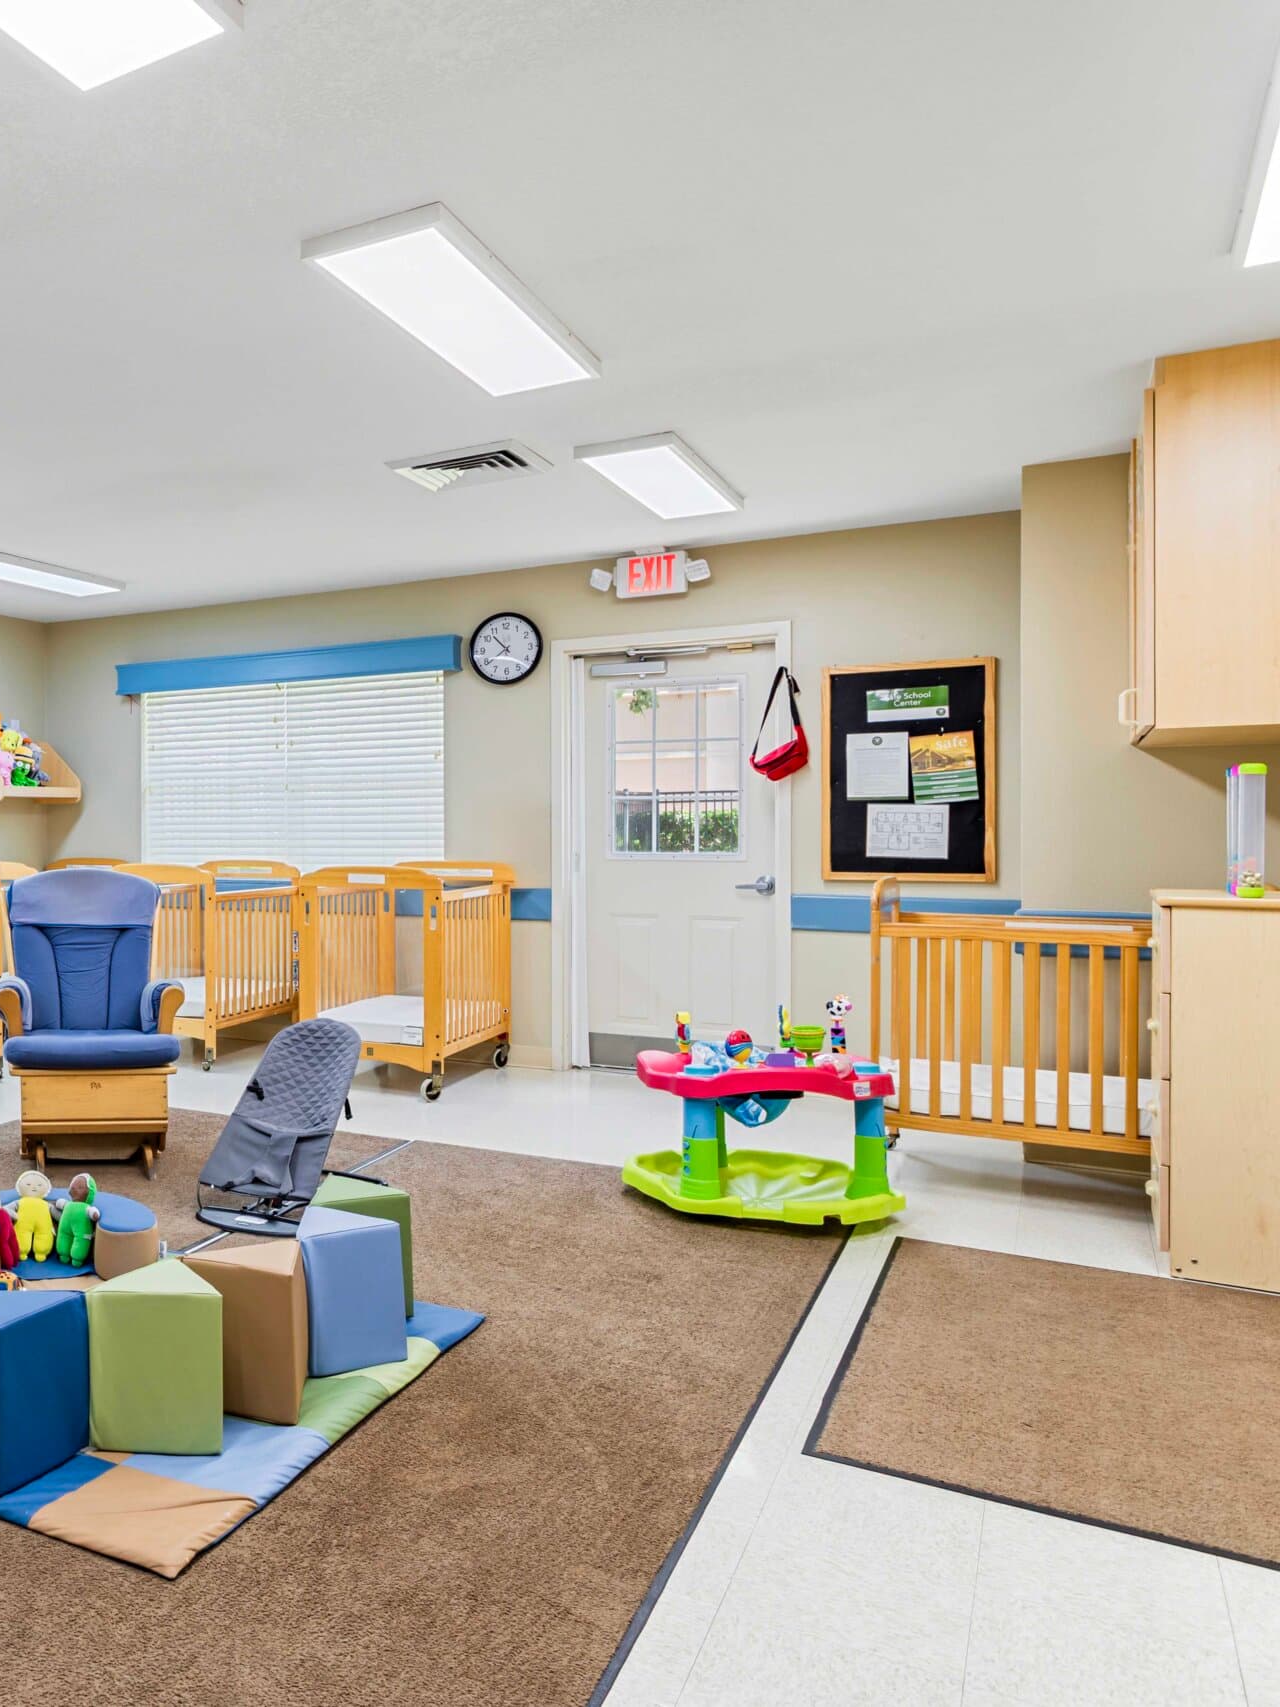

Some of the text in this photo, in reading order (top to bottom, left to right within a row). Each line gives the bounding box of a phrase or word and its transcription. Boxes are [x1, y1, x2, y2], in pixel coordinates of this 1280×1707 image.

[628, 554, 677, 593] EXIT
[502, 622, 510, 630] 12
[491, 627, 498, 635] 11
[480, 647, 486, 655] 9
[504, 667, 509, 675] 6
[903, 690, 931, 700] School
[936, 736, 967, 749] safe
